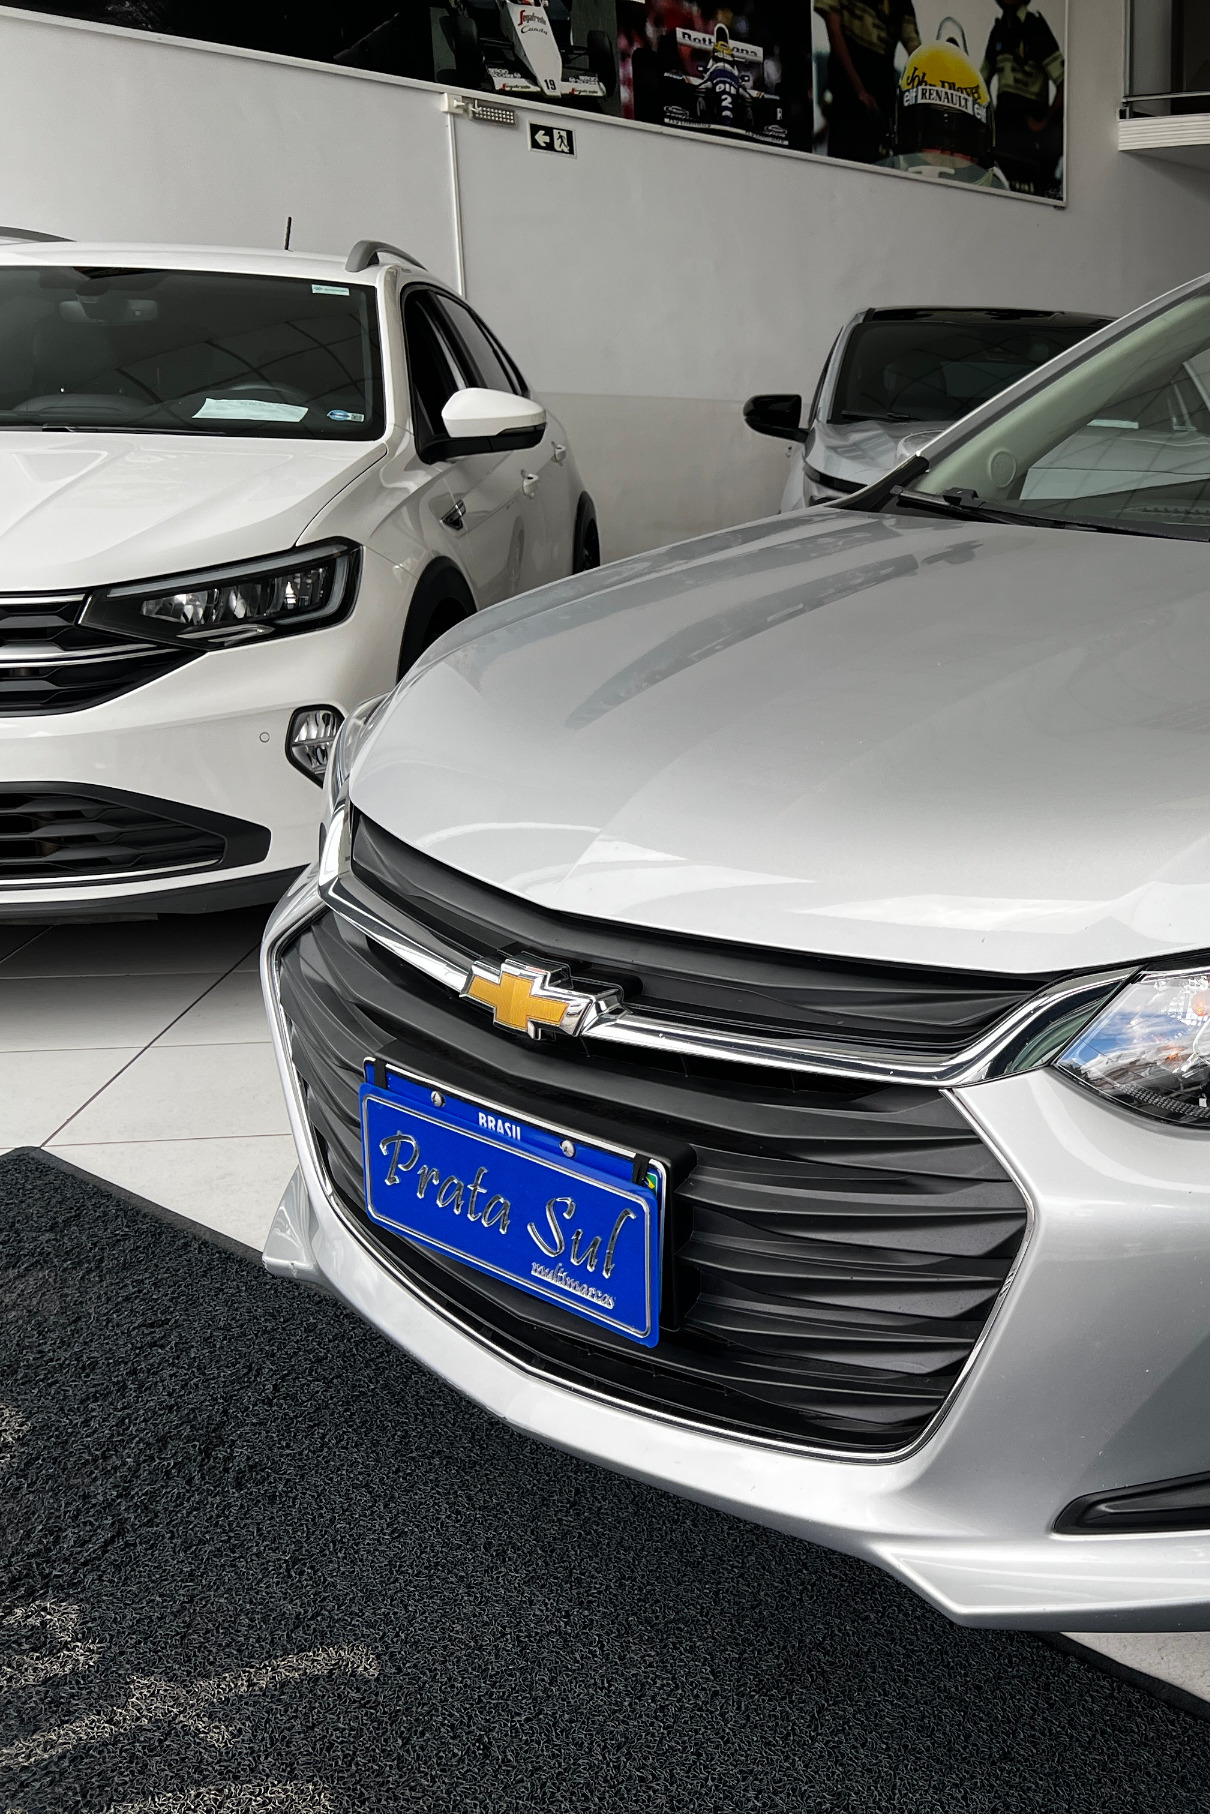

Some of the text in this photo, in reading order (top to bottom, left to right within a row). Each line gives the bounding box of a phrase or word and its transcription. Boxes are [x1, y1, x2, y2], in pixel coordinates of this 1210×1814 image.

[543, 79, 557, 91] 19
[720, 94, 733, 108] 2
[920, 88, 970, 111] RENAULT
[379, 1129, 637, 1279] Prata Sul
[530, 1261, 616, 1310] multimarcas
